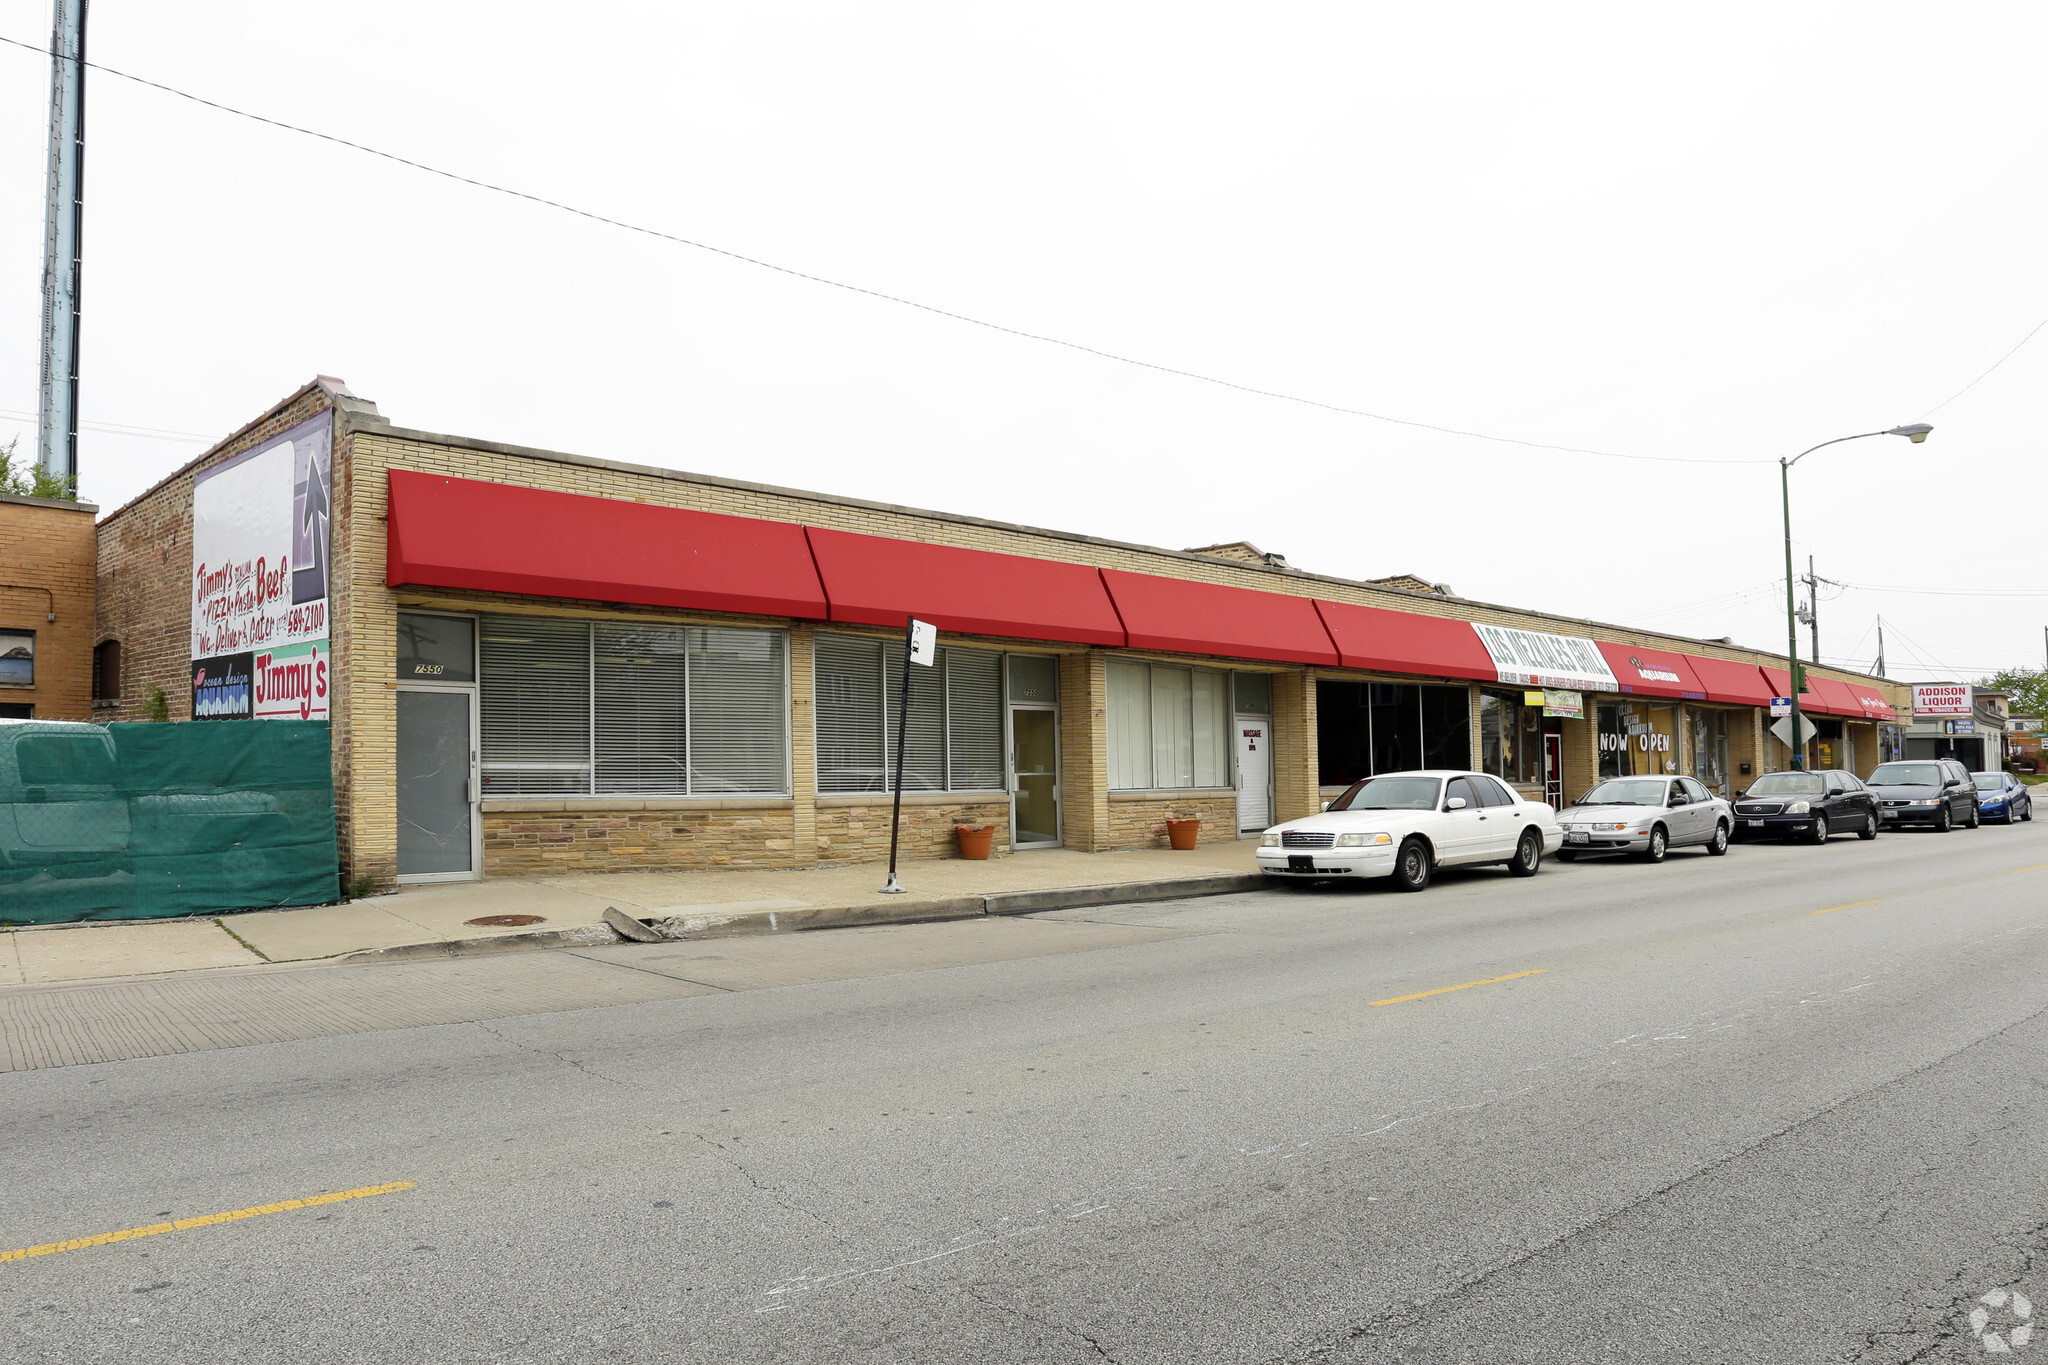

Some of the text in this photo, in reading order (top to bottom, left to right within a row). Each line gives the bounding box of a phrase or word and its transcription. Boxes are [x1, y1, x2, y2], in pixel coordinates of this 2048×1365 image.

[197, 558, 232, 604] Jimmy's
[257, 555, 287, 607] Beef
[215, 618, 242, 653] Deliver
[249, 609, 274, 645] Cater
[1476, 625, 1610, 676] LOS MEZKALES GRILL
[203, 663, 249, 687] ocean design
[256, 646, 327, 720] Jimmy's
[416, 665, 443, 674] 7550
[195, 684, 249, 717] AQUARIUM
[1918, 687, 1966, 696] ADDISON
[1922, 697, 1962, 706] LIQUOR
[1600, 732, 1670, 751] NOW OPEN
